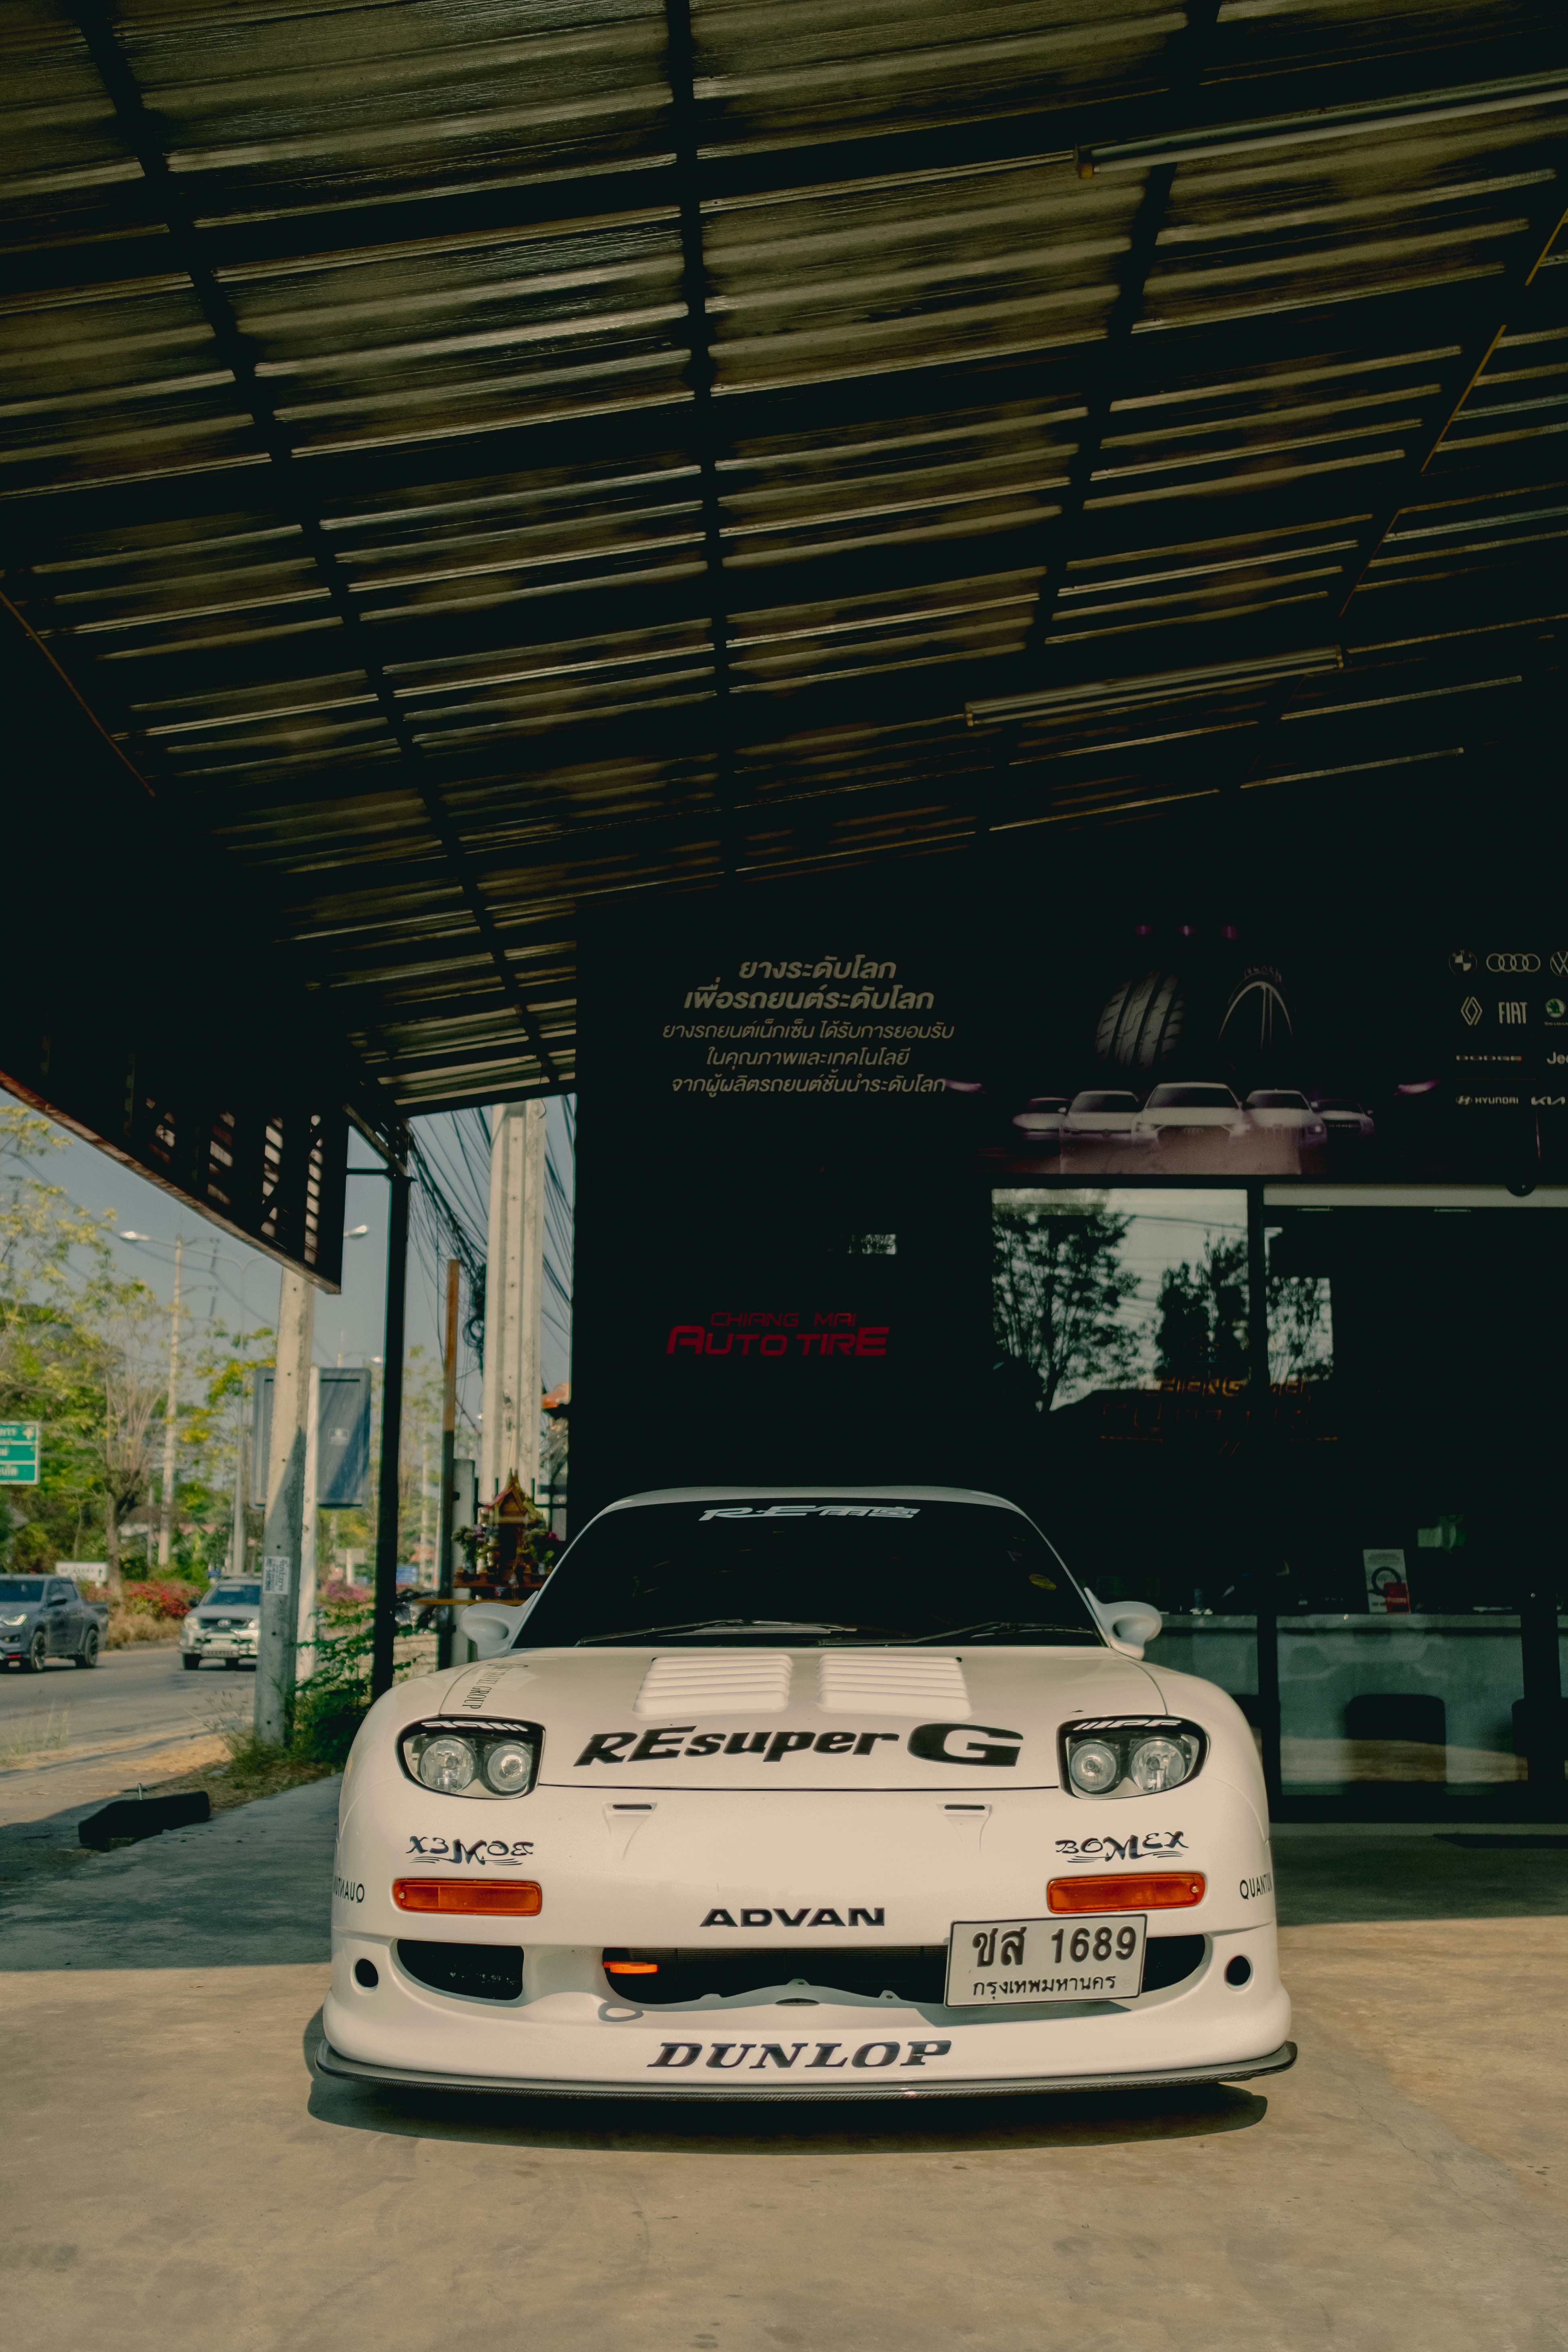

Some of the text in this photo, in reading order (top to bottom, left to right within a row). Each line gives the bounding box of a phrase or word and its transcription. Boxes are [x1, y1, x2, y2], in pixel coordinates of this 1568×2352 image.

[739, 954, 897, 979] ยางระดับโลก
[683, 976, 935, 1010] เพื่อรถยนต์ระดับโลก
[1498, 1001, 1528, 1025] FIAT
[662, 1018, 955, 1039] ยางรถยนต์เน็กเซ็น ได้รับการยอมรับ
[706, 1046, 912, 1071] ในคุณภาพและเทคโนโลยี
[1546, 1051, 1568, 1065] Je
[671, 1068, 947, 1098] จากผู้ผลิตรถยนต์ชั้นนำระดับโลก
[1475, 1096, 1519, 1105] HYUNDAI
[710, 1311, 858, 1327] CHIANG MAI
[666, 1325, 890, 1356] AUTO TIRE
[461, 1686, 492, 1709] GROUP
[1054, 1830, 1191, 1863] BOMEX
[699, 1907, 885, 1927] ADVAN
[1051, 1925, 1137, 1964] 1689
[973, 1975, 1116, 2000] กรุงเทพมหานคร
[646, 2040, 952, 2069] DUNLOP
